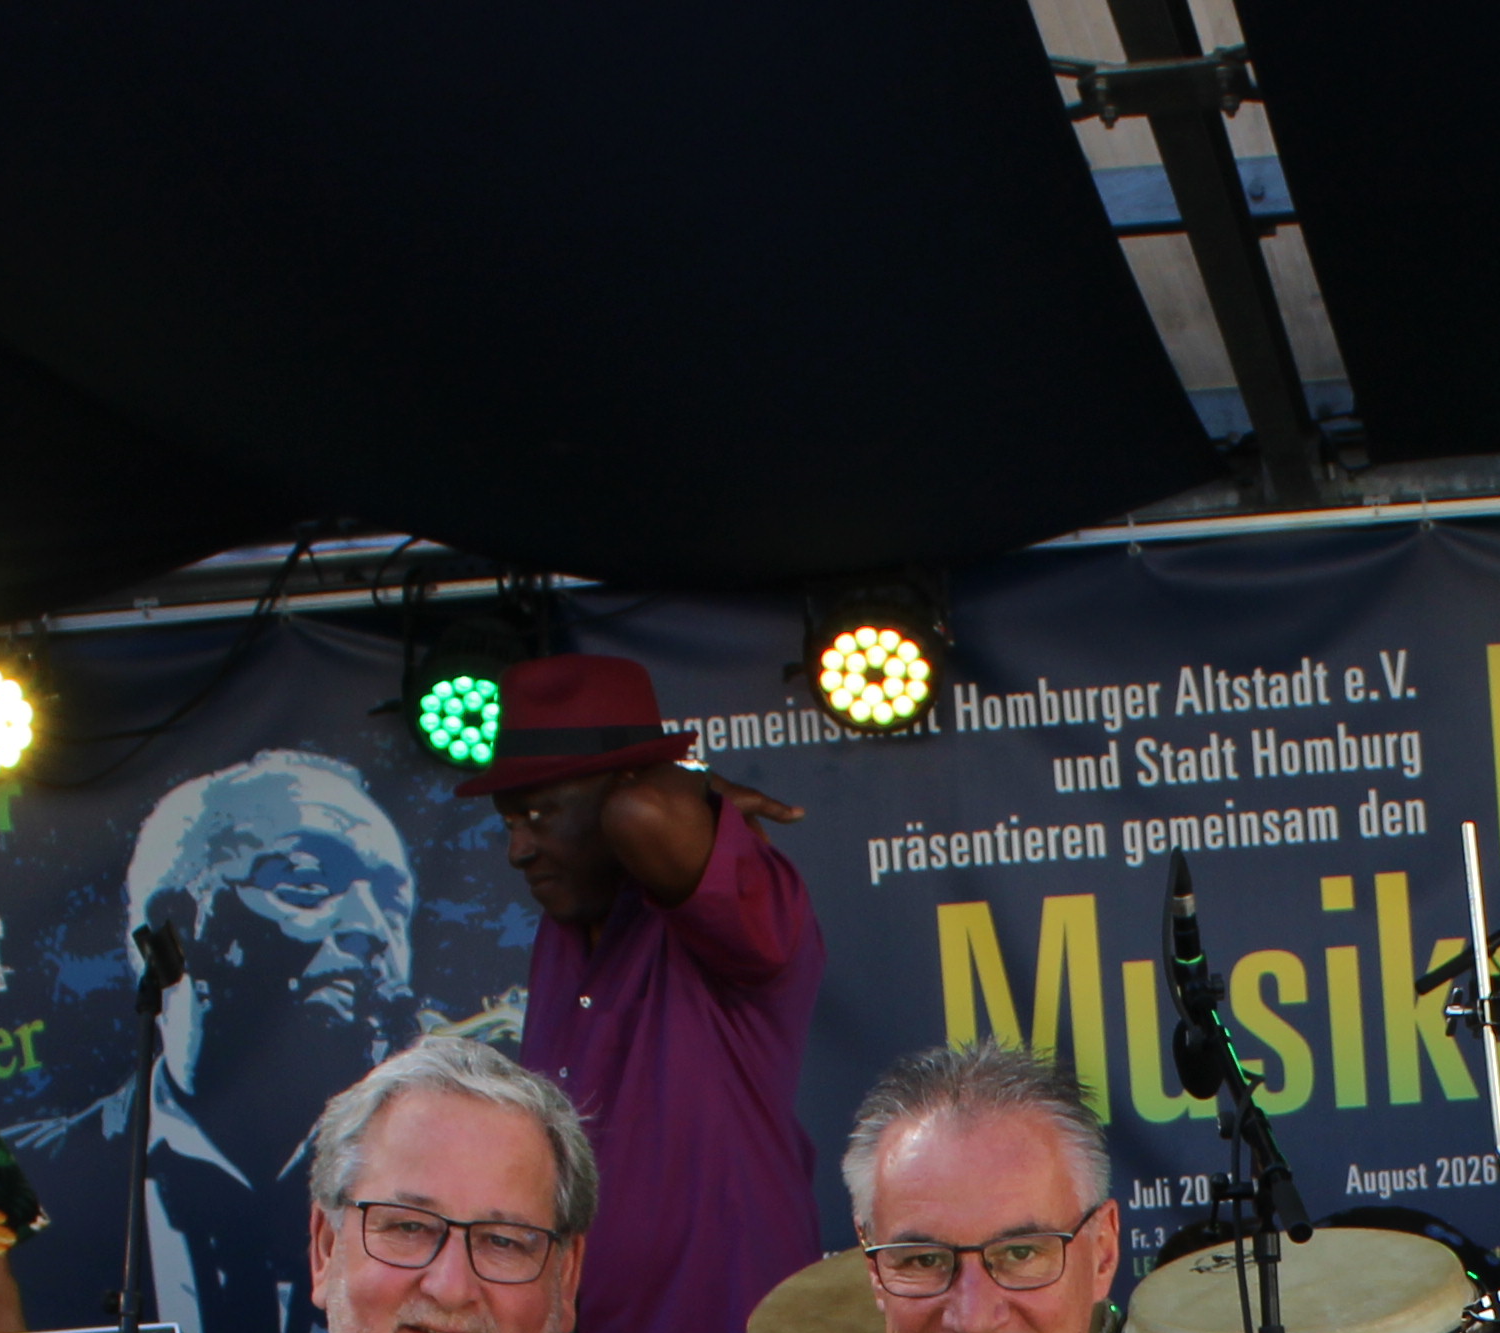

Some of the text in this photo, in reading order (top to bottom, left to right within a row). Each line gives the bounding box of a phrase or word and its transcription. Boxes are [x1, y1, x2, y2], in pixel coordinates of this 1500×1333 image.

[954, 678, 1161, 738] Homburger
[1174, 658, 1331, 717] Altstadt
[1343, 650, 1418, 703] e.V.
[1053, 726, 1425, 794] und Stadt Homburg
[868, 789, 1428, 886] präsentieren gemeinsam den
[1129, 1178, 1173, 1211] Juli
[1344, 1153, 1499, 1201] August 2026
[1131, 1226, 1151, 1249] Fr.
